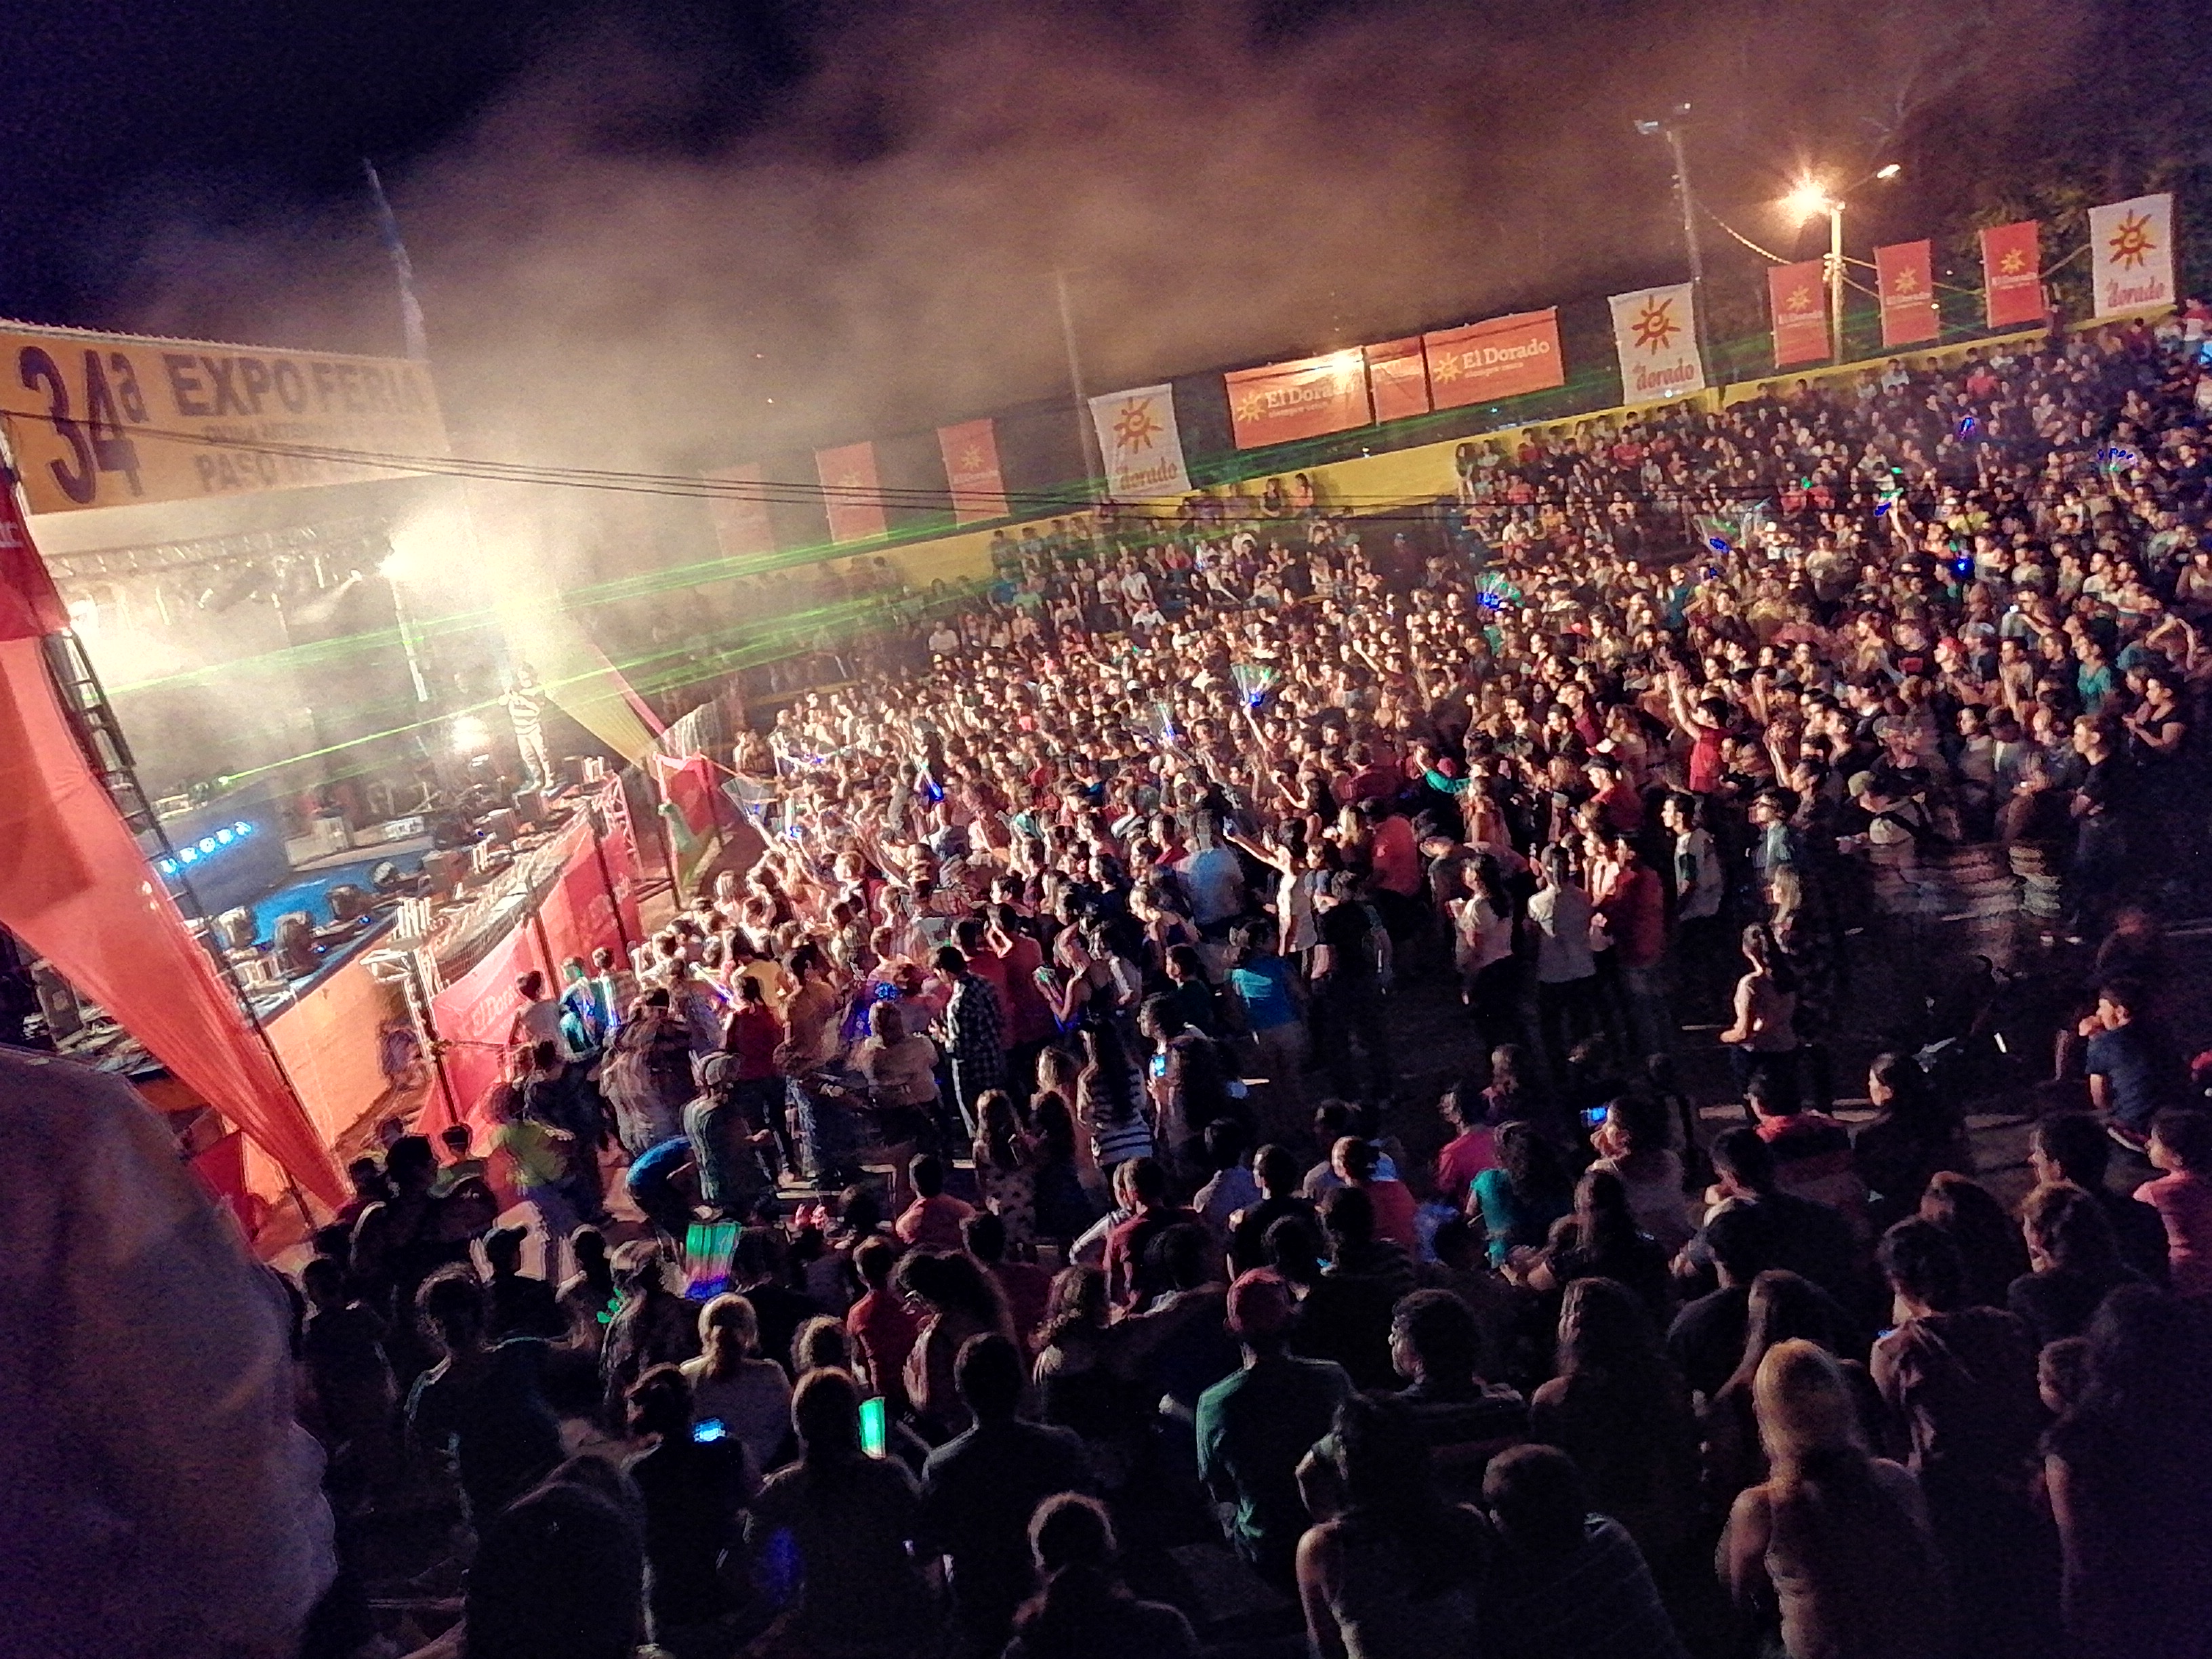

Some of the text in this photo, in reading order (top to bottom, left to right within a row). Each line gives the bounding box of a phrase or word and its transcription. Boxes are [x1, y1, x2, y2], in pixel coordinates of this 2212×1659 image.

[1462, 338, 1550, 369] El Dorado
[1288, 376, 1354, 405] Dora
